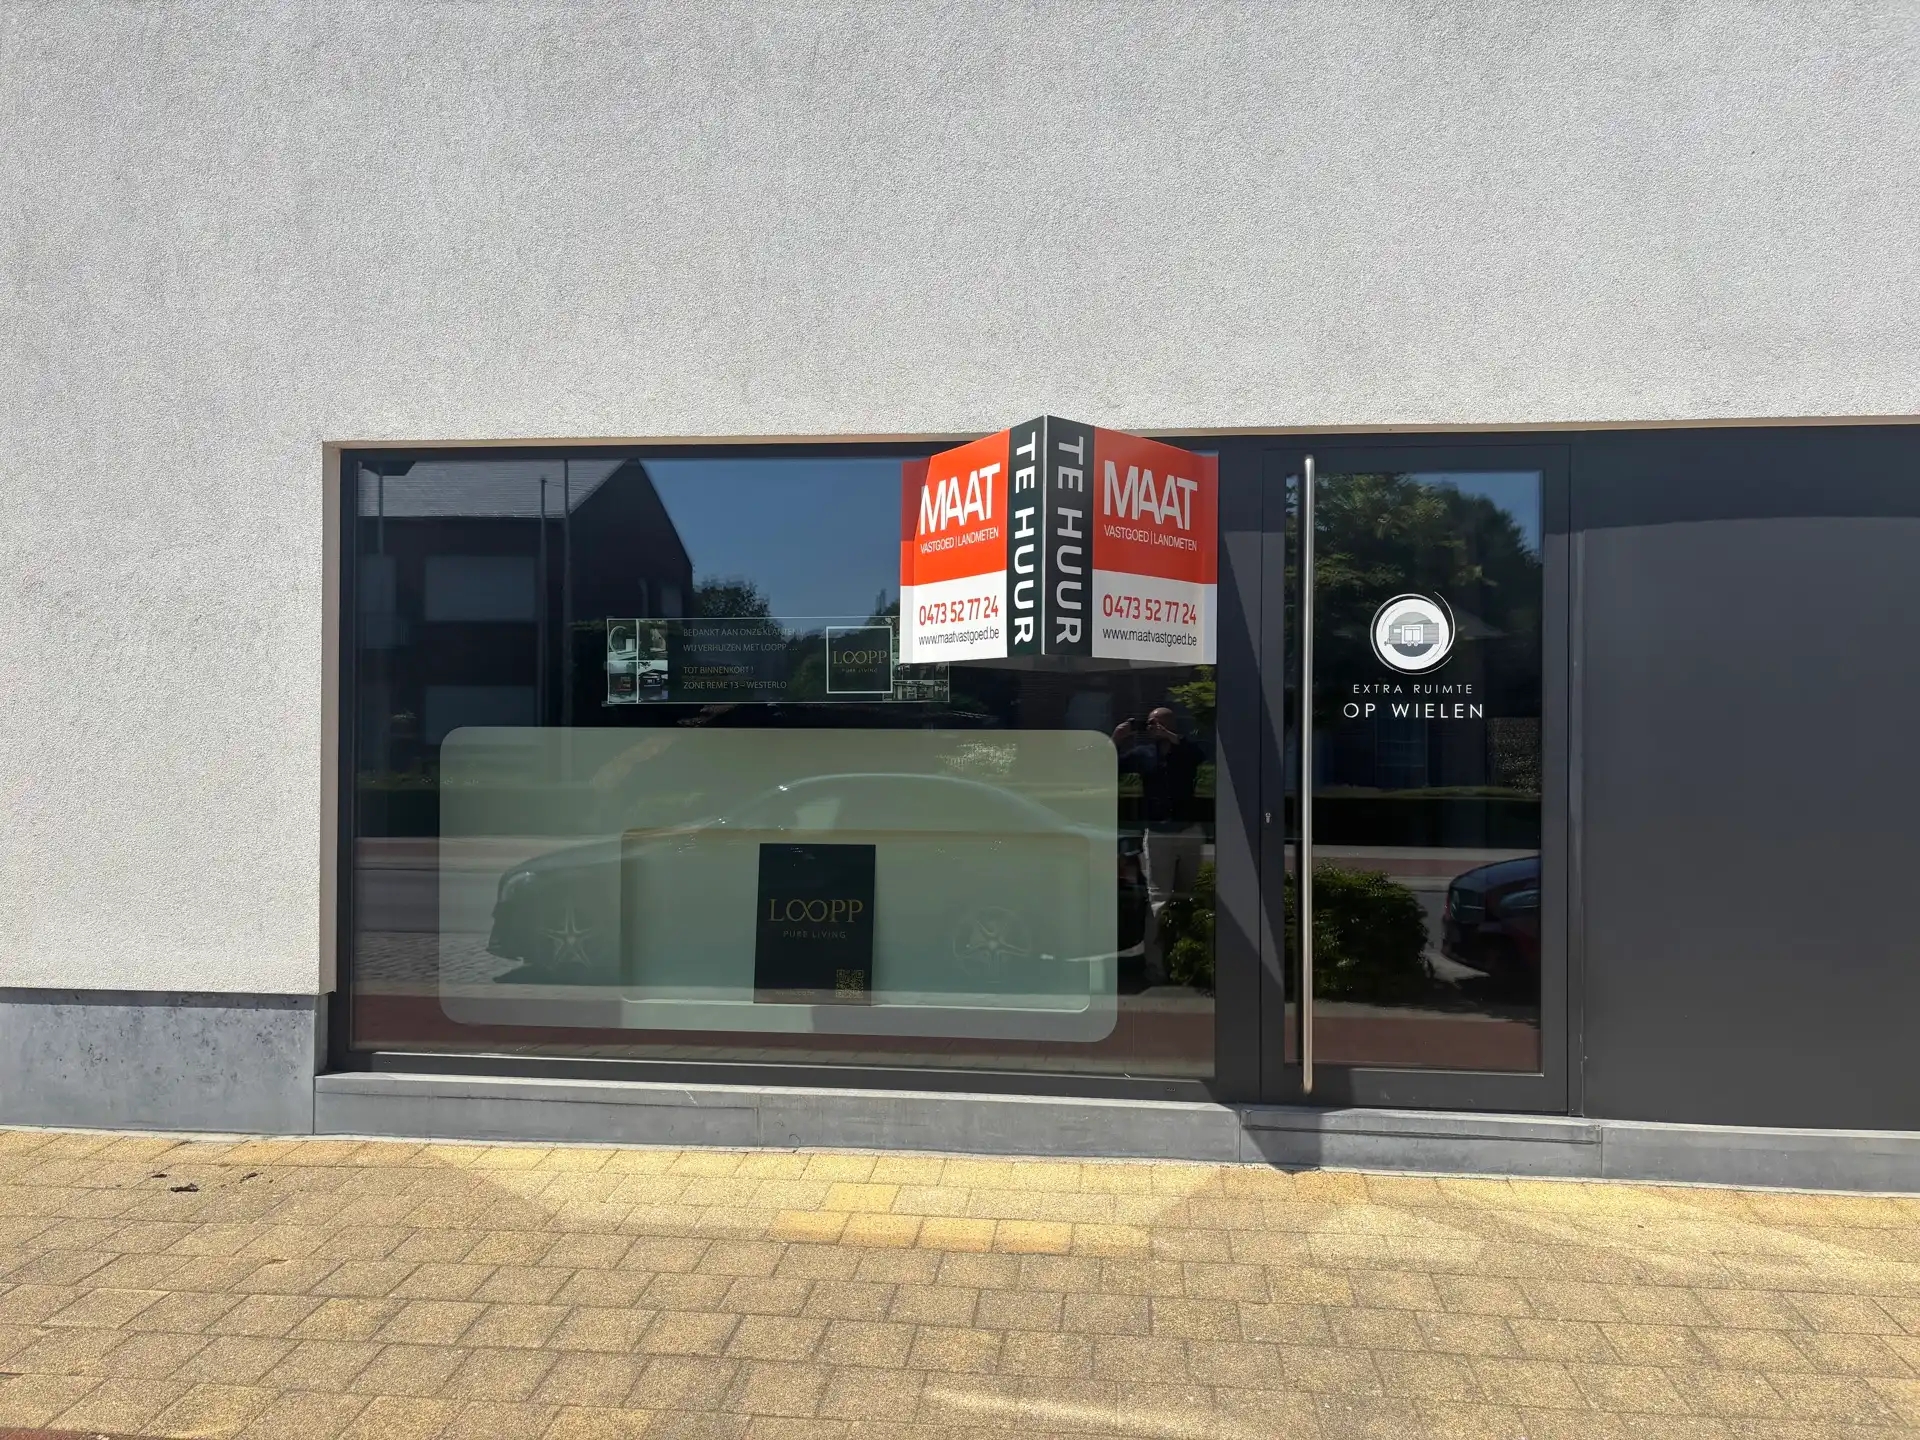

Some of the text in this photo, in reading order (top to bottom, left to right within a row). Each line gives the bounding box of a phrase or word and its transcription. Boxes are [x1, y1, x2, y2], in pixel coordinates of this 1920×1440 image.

[919, 462, 1000, 536] MAAT
[1103, 459, 1198, 531] MAAT
[920, 526, 999, 554] VASTGOED LANDMETEN
[1014, 431, 1036, 646] TE HUUR
[1056, 436, 1084, 645] TE HUUR
[1103, 523, 1198, 552] VASTGOED LANDMETEN
[918, 595, 999, 626] 0473 52 77 24
[1102, 593, 1197, 625] 0473 52 77 24
[683, 628, 720, 637] BEDANKT
[721, 628, 739, 636] AAN
[740, 628, 762, 636] ONZE
[918, 625, 1000, 646] www.maatvastgoed.be
[1102, 628, 1198, 648] www.maatvastgoed.be
[683, 644, 697, 652] WIJ
[698, 643, 741, 652] VERHUIZEN
[743, 643, 760, 651] MET
[761, 643, 787, 651] LOOPP
[833, 650, 888, 664] LOOPP
[683, 666, 699, 674] TOT
[700, 666, 750, 674] BINNENKORT
[683, 681, 705, 689] ZONE
[706, 681, 728, 689] REME
[730, 681, 739, 689] 13
[746, 681, 787, 689] WESTERLO
[1353, 684, 1473, 695] EXTRA RUIMTE
[1343, 702, 1484, 719] OP WIELEN
[768, 898, 864, 923] LOOPP
[783, 930, 847, 939] PURE LIVING
